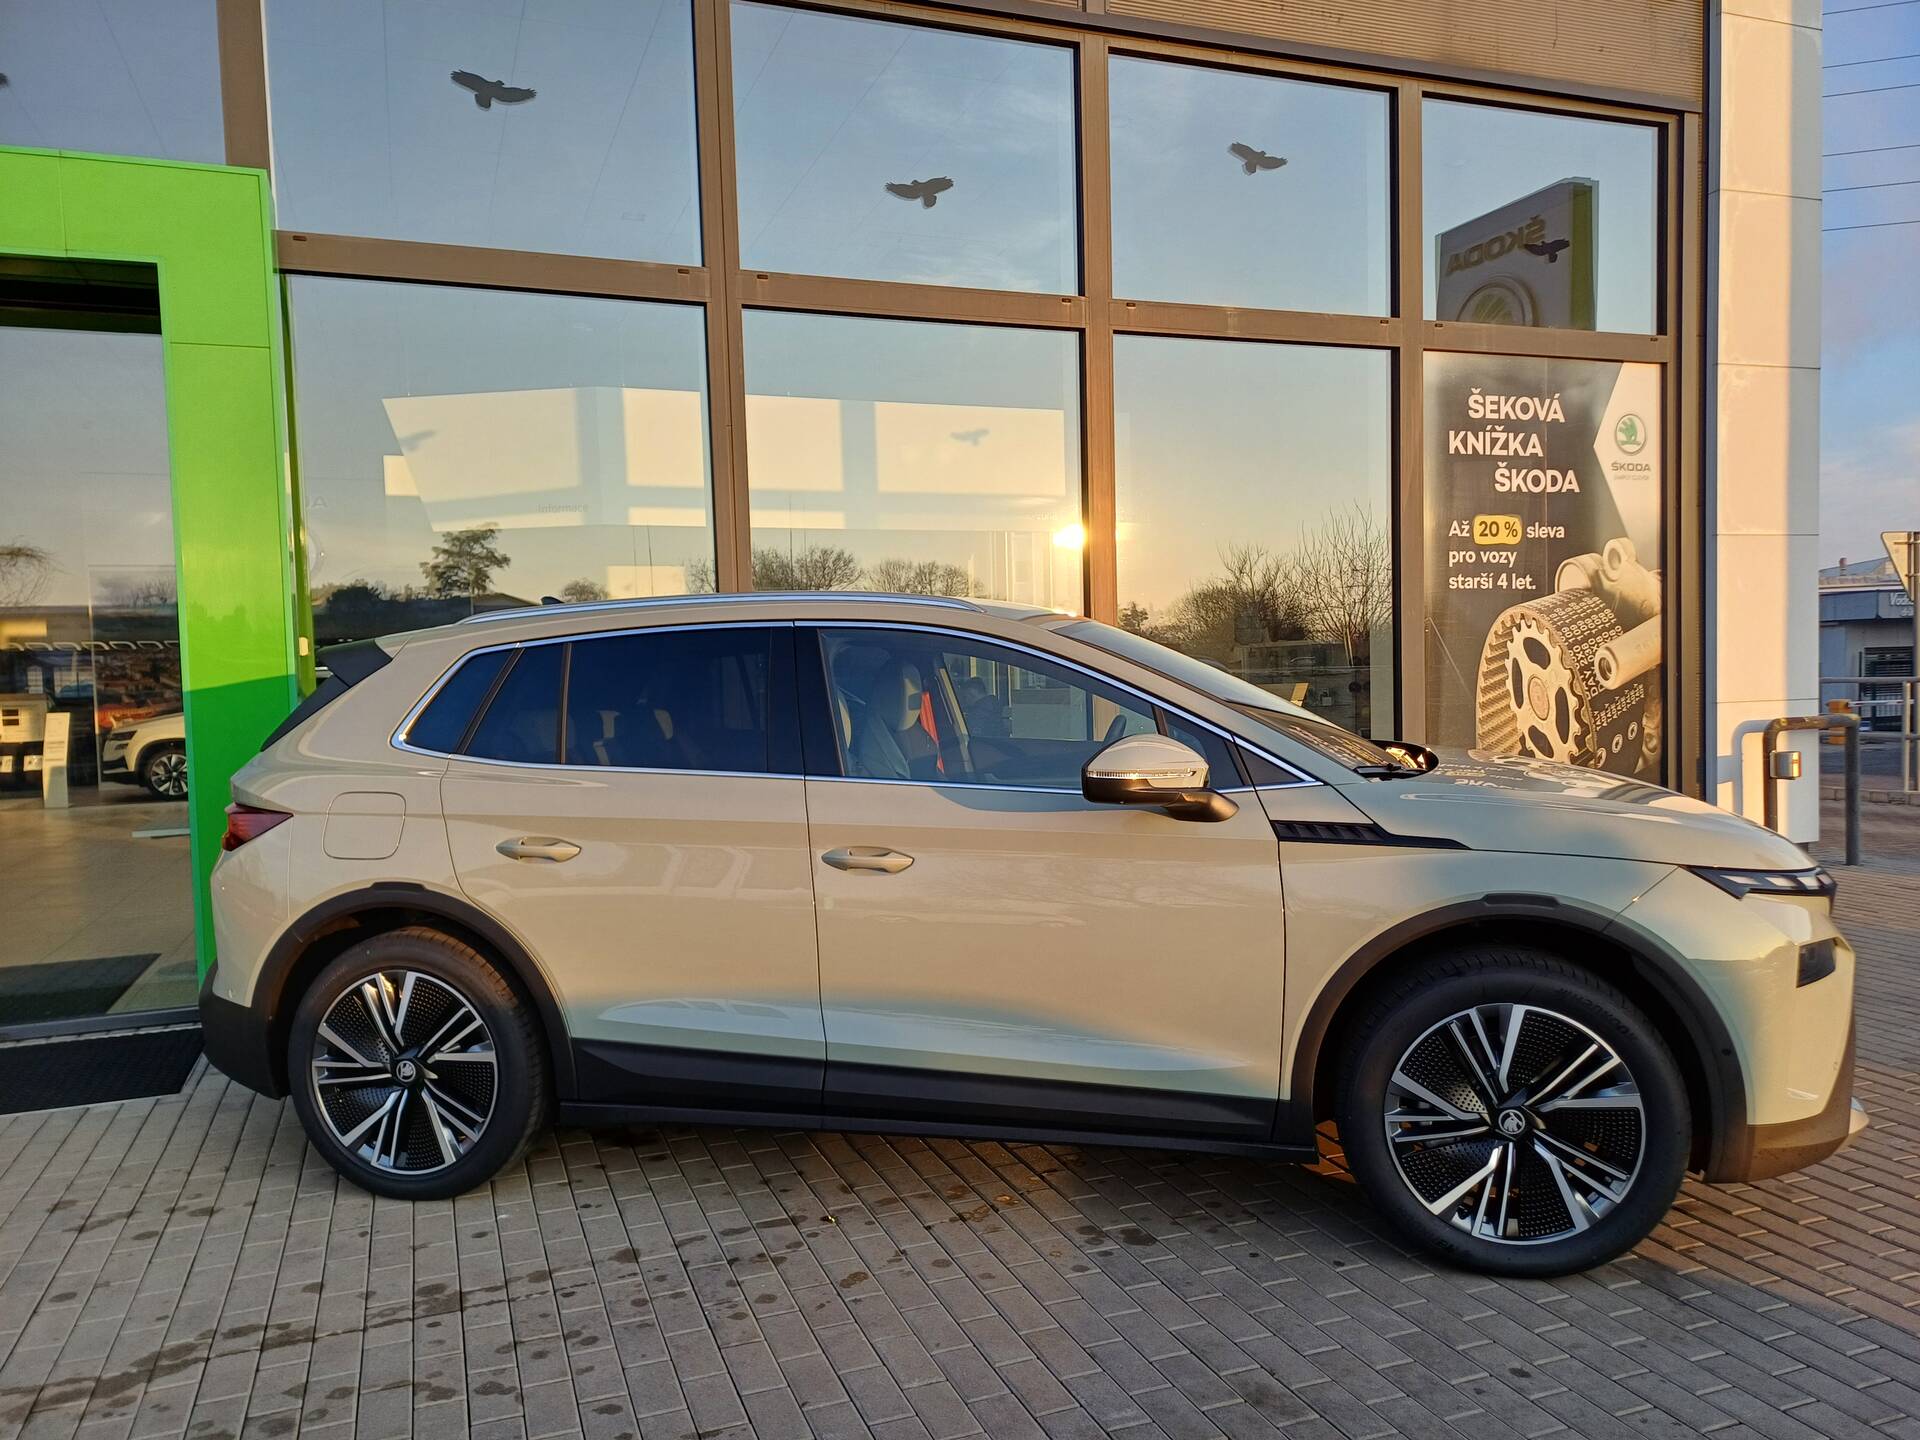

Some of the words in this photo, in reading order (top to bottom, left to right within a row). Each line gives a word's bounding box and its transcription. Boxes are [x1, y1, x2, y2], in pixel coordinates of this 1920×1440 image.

[1468, 388, 1565, 423] ŠEKOVÁ
[1449, 425, 1544, 457] KNÍŽKA
[1494, 462, 1580, 493] ŠKODA
[1448, 520, 1470, 538] Až
[1478, 521, 1499, 537] 20
[1504, 521, 1518, 537] %
[1526, 523, 1565, 539] sleva
[1448, 551, 1476, 568] pro
[1480, 551, 1517, 569] vozy
[1449, 572, 1493, 590] starší
[1497, 573, 1508, 589] 4
[1511, 573, 1537, 590] let.
